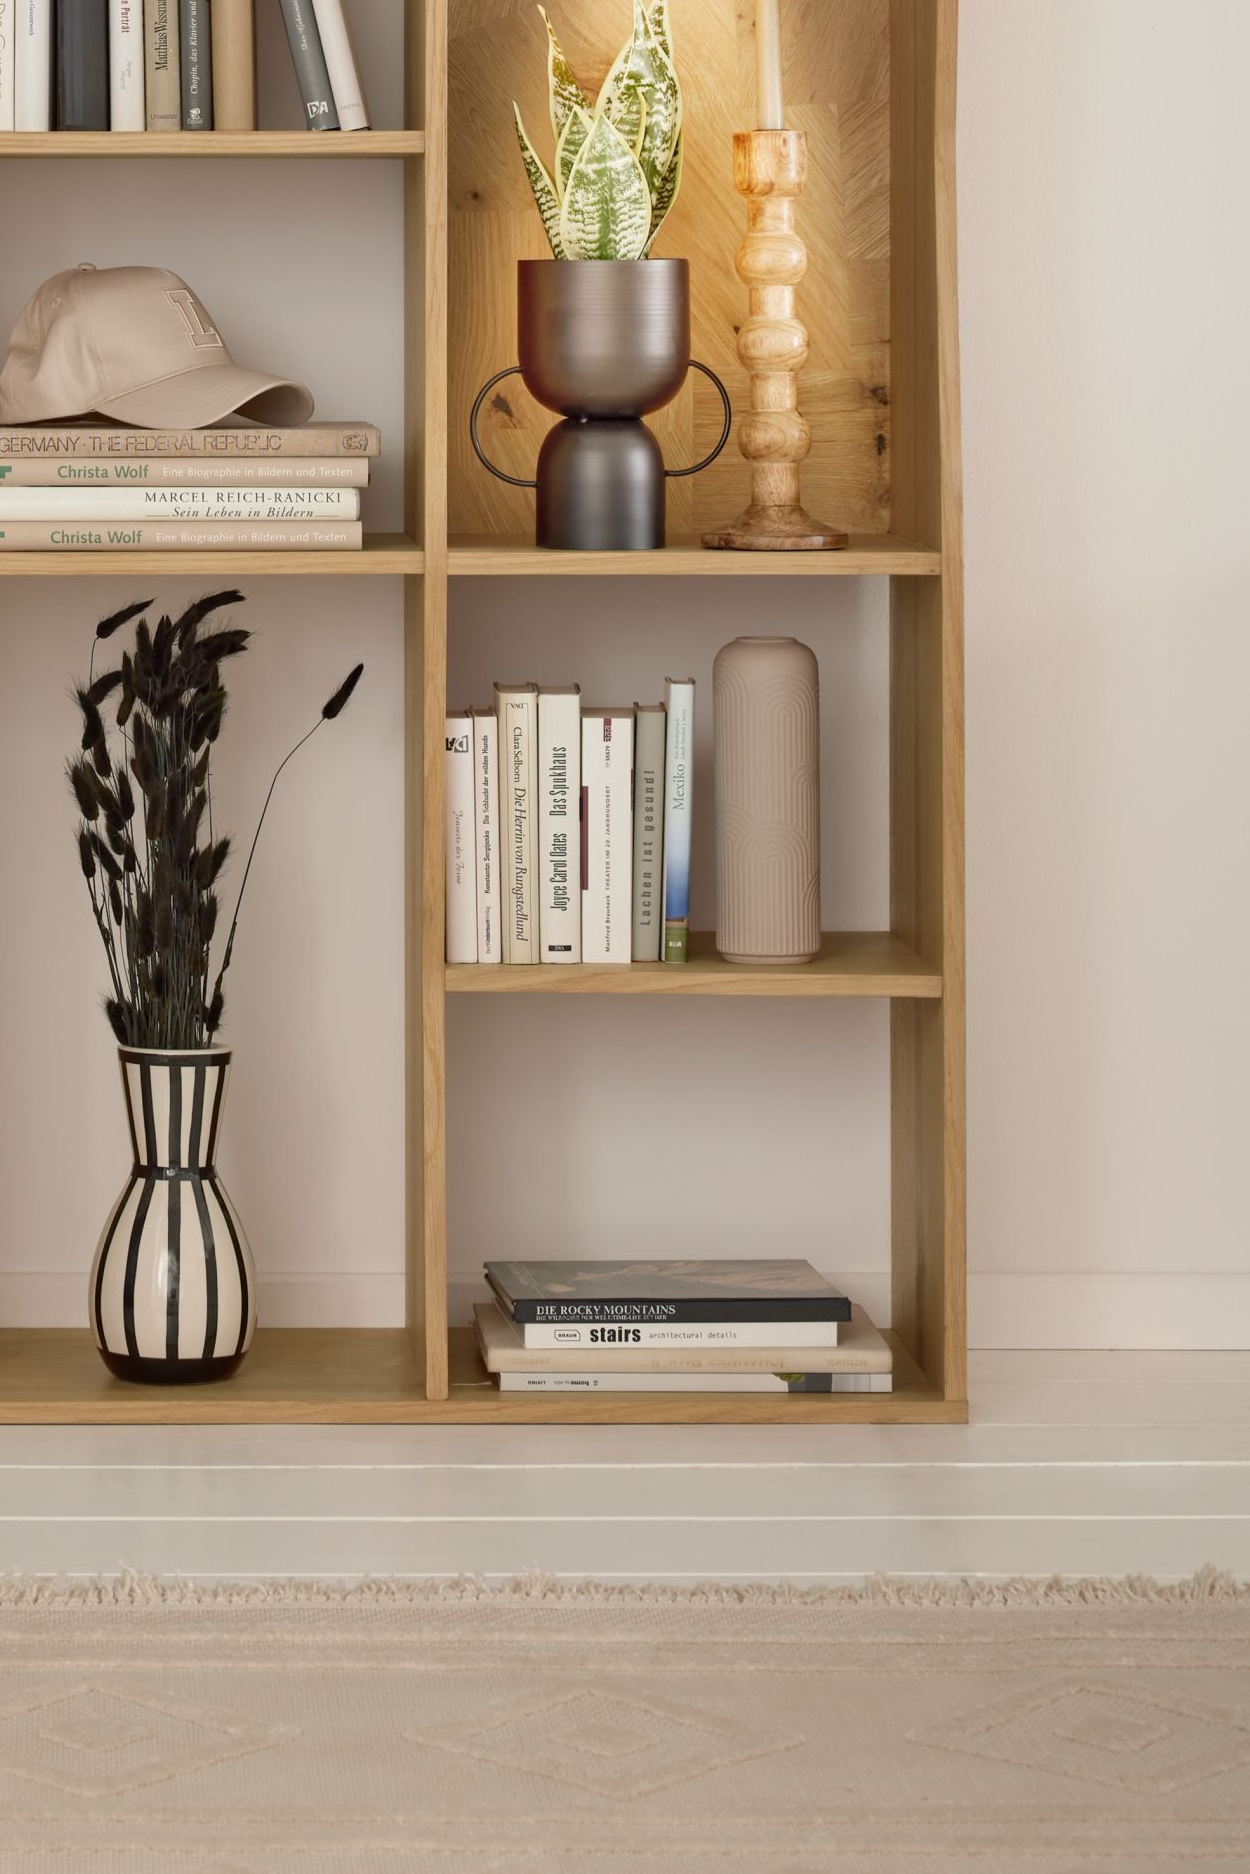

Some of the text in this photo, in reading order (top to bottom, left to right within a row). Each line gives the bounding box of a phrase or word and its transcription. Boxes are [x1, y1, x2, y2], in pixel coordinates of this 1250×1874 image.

[189, 1, 197, 16] und
[120, 7, 131, 33] Porträt
[189, 19, 197, 46] Klavier
[190, 65, 200, 94] Chopin,
[165, 288, 223, 350] L
[0, 436, 80, 453] GERMANY
[89, 435, 121, 452] THE
[57, 464, 353, 481] Christa Wolf Eine Biographie in Bildern und Texten
[145, 492, 341, 503] MARCEL REICH-RANICKI
[172, 506, 314, 518] Sein Leben in Bildern
[50, 530, 346, 546] Christa Wolf Eine Biographie in Bildern und Texten
[672, 763, 686, 810] Mexiko
[511, 726, 529, 942] Clara Selborn Die Herrin von Rungstedlund
[549, 746, 570, 912] Joyce Carol Oates Das Spukhaus
[605, 850, 611, 859] IM
[640, 770, 655, 925] Lachen ist gesund!
[536, 1305, 676, 1315] DIE ROCKY MOUNTAINS
[590, 1326, 737, 1343] stairs architectural details
